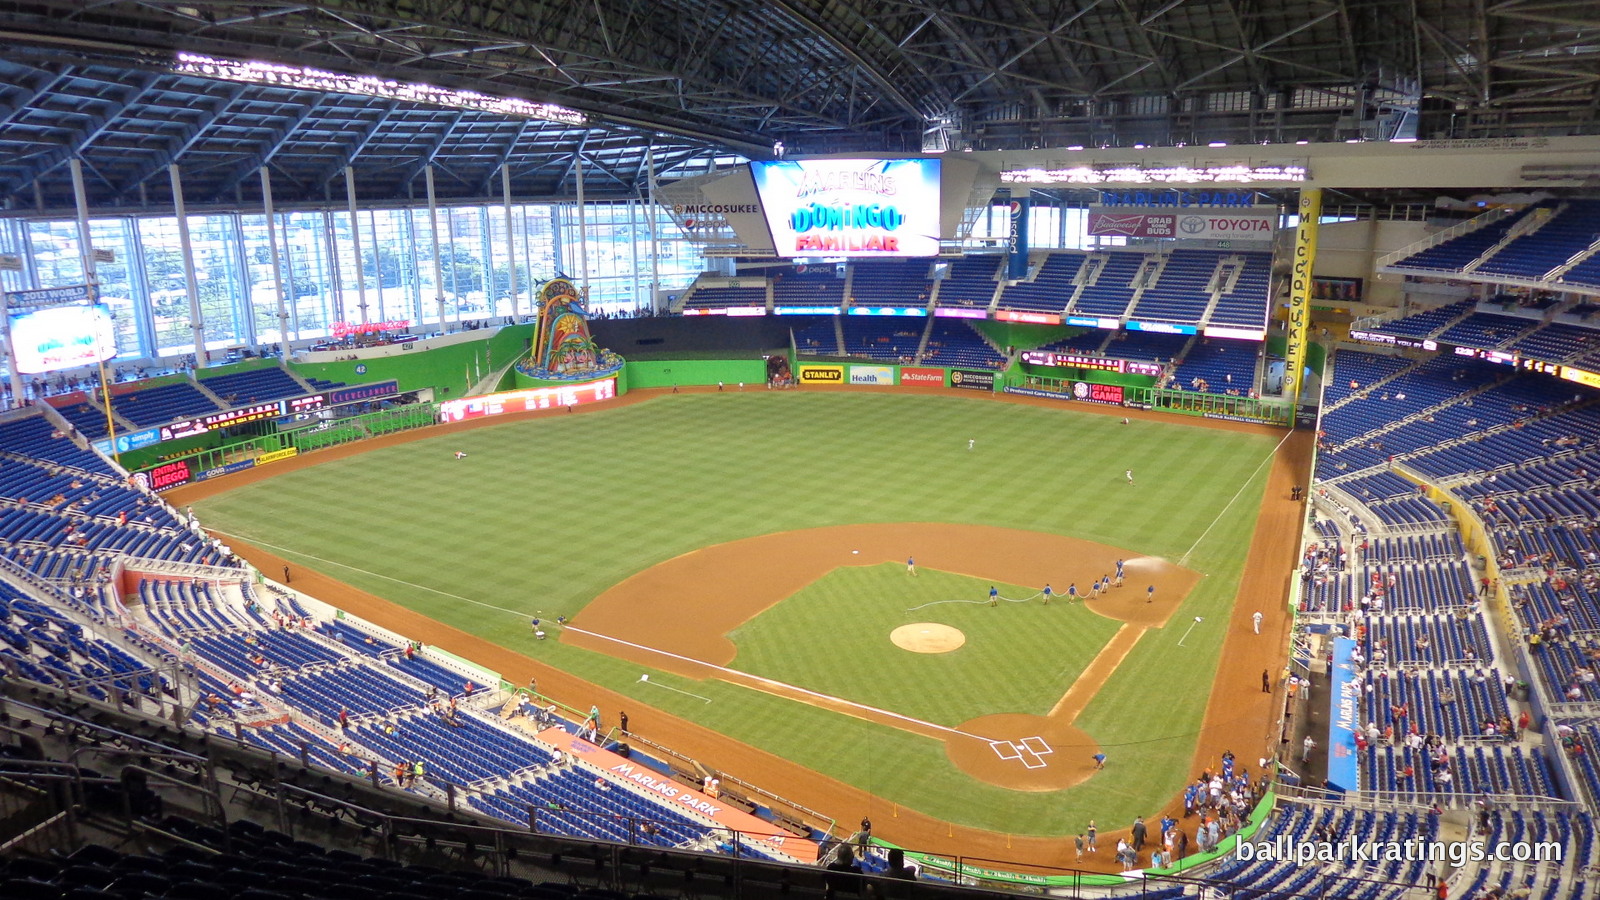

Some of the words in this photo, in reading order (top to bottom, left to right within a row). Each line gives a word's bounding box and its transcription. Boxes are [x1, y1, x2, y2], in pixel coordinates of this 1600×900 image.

[796, 170, 897, 197] MARLINS
[1102, 191, 1191, 207] MARLINS
[1200, 192, 1253, 208] PARK
[685, 204, 757, 213] MICCOSUKEE
[793, 203, 902, 233] DOMINGO
[1095, 218, 1141, 229] Budweiser
[697, 220, 728, 230] pepsi
[1147, 227, 1171, 235] BUDS
[1209, 219, 1270, 231] TOYOTA
[796, 234, 899, 251] FAMILIAR
[1009, 219, 1018, 254] pepsi
[809, 266, 831, 274] pepsi
[23, 290, 47, 300] 2013
[48, 287, 85, 298] WORLD
[1286, 212, 1310, 371] MICCOSUKEE
[328, 320, 411, 337] Budweiser
[804, 371, 839, 379] STANLEY
[852, 374, 877, 383] Health
[332, 385, 397, 403] CLEVELANDER
[1009, 388, 1033, 396] Preferred
[1092, 391, 1122, 402] GAME!
[131, 431, 154, 442] simply
[177, 461, 186, 469] AL
[154, 469, 189, 488] JUEGO!
[1340, 681, 1353, 698] PARK
[1336, 699, 1353, 731] MARLINS
[611, 763, 679, 797] MARLINS
[677, 793, 721, 817] PARK
